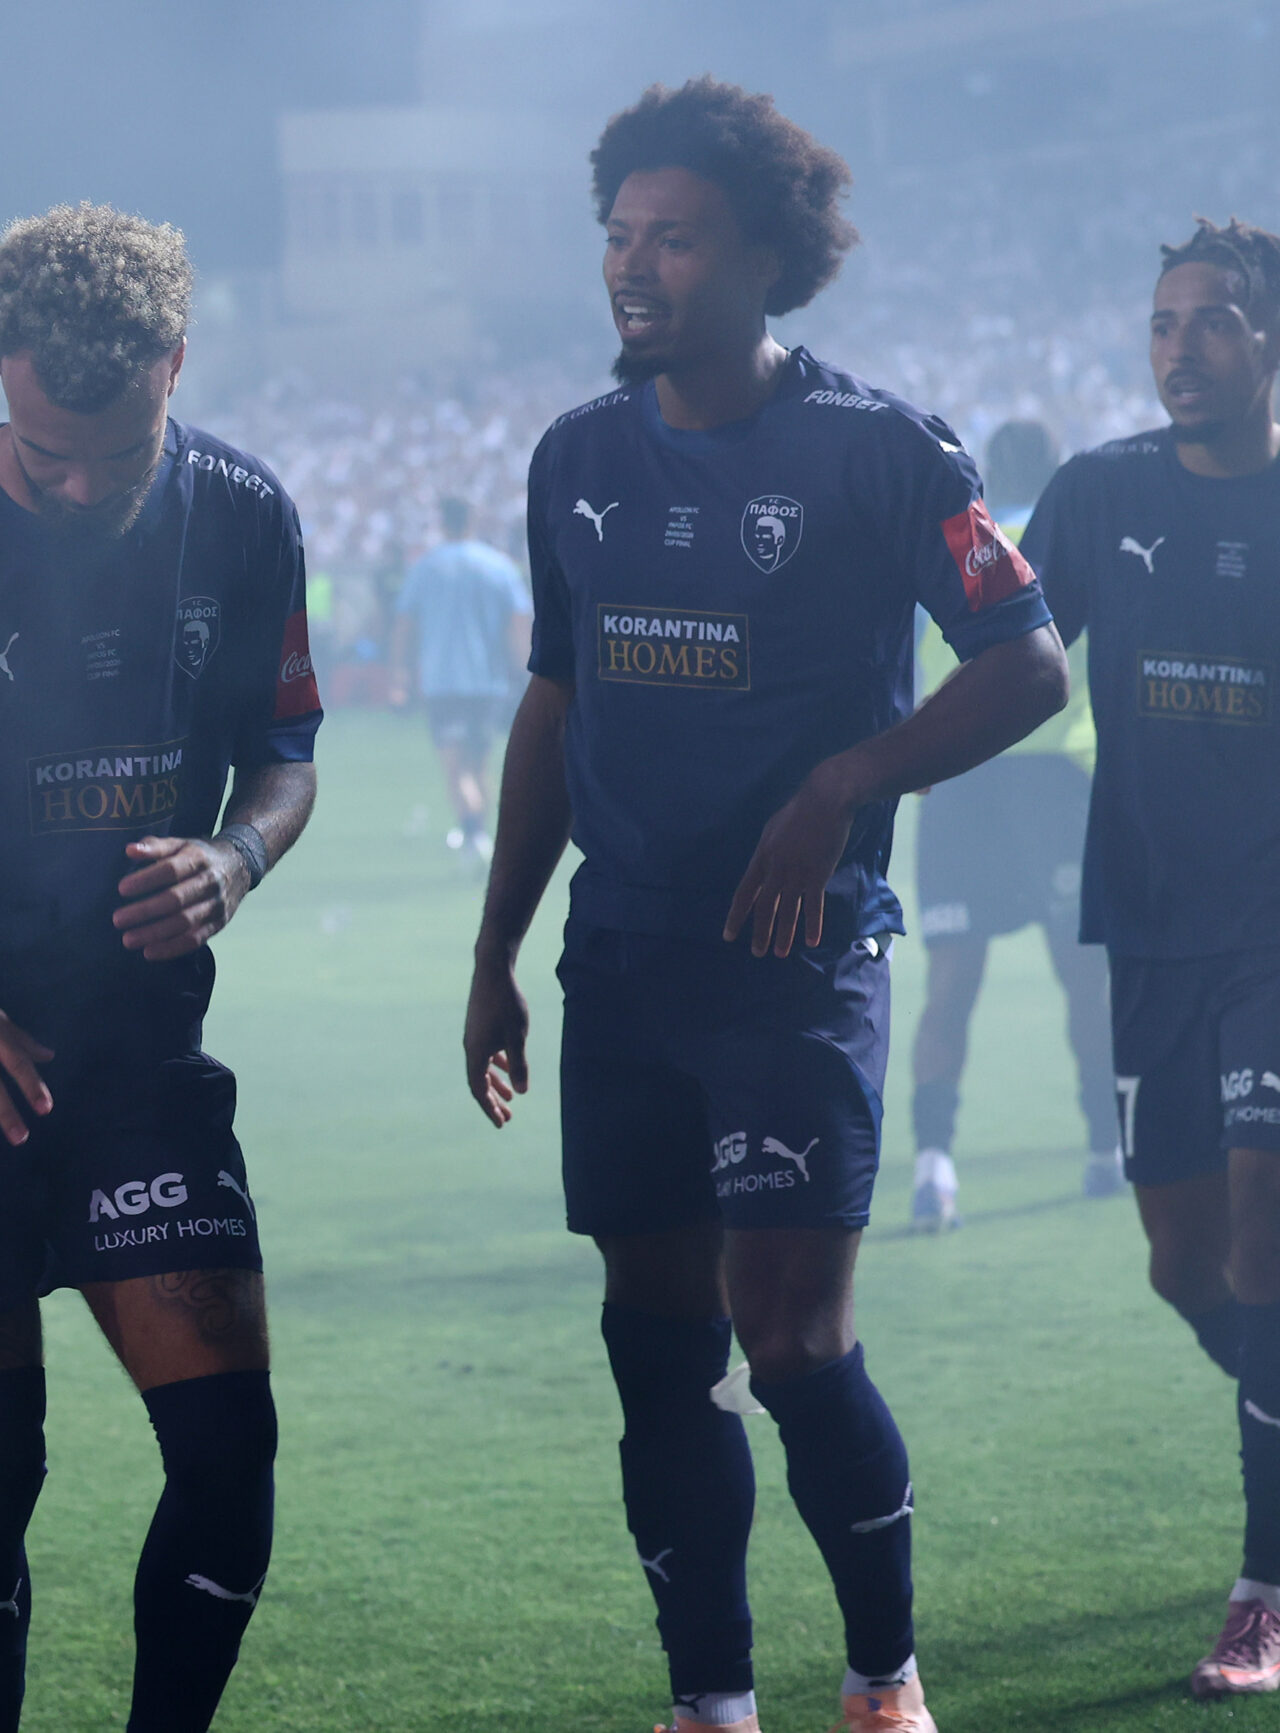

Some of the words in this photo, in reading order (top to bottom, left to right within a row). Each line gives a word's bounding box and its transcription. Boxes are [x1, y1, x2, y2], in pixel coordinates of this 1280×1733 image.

[803, 389, 890, 412] FONBET
[187, 449, 275, 499] FONBET
[749, 504, 799, 518] ΠΑΦΟΣ
[603, 614, 740, 643] KORANTINA
[607, 640, 739, 679] HOMES
[1143, 659, 1266, 687] KORANTINA
[1147, 680, 1264, 717] HOMES
[36, 749, 183, 785] KORANTINA
[42, 774, 179, 821] HOMES
[88, 1173, 188, 1222] AGG
[733, 1170, 795, 1194] HOMES
[95, 1222, 169, 1251] LUXURY
[177, 1218, 246, 1237] HOMES
